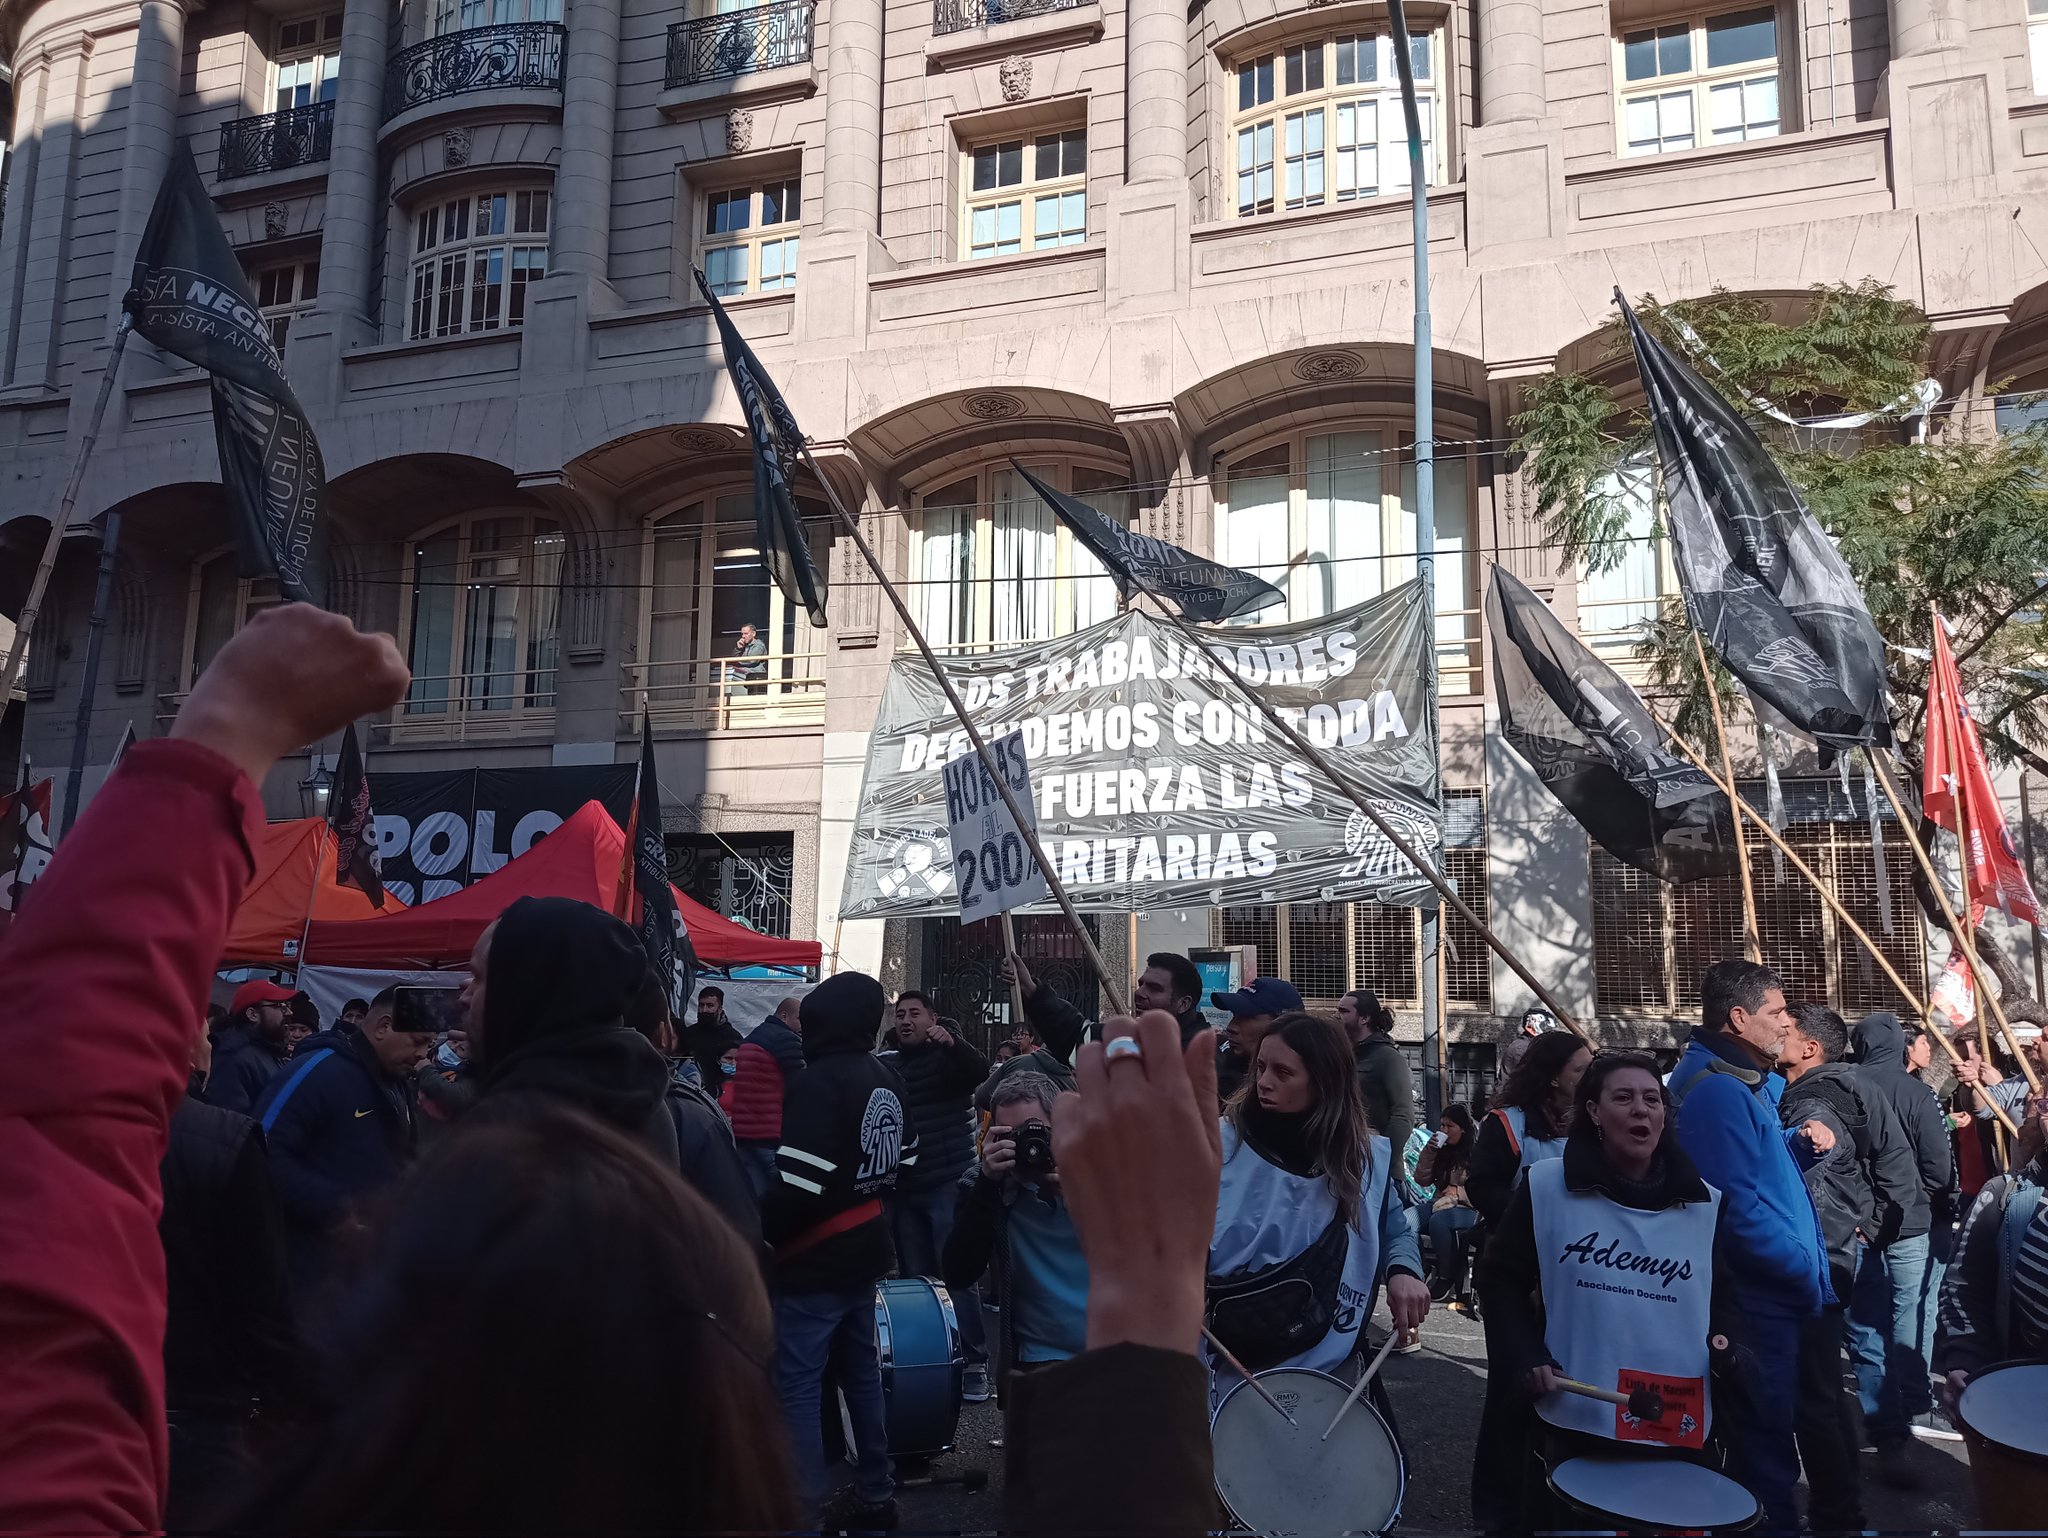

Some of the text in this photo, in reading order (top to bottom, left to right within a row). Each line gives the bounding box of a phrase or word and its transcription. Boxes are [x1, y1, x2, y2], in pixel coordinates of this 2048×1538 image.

[1215, 587, 1250, 600] LUCHA
[1024, 631, 1357, 700] TRABAJADORES
[899, 689, 1409, 773] DEFDEMOS CON TODA
[945, 732, 1028, 826] HORAS
[1041, 761, 1314, 820] FUERZA LAS
[887, 833, 911, 859] UNIDOS
[919, 829, 949, 858] ADELANTE
[982, 810, 1004, 842] AL
[1559, 1231, 1693, 1289] Ademys
[1576, 1278, 1678, 1304] Asociación Docente
[1277, 1392, 1297, 1402] RMV
